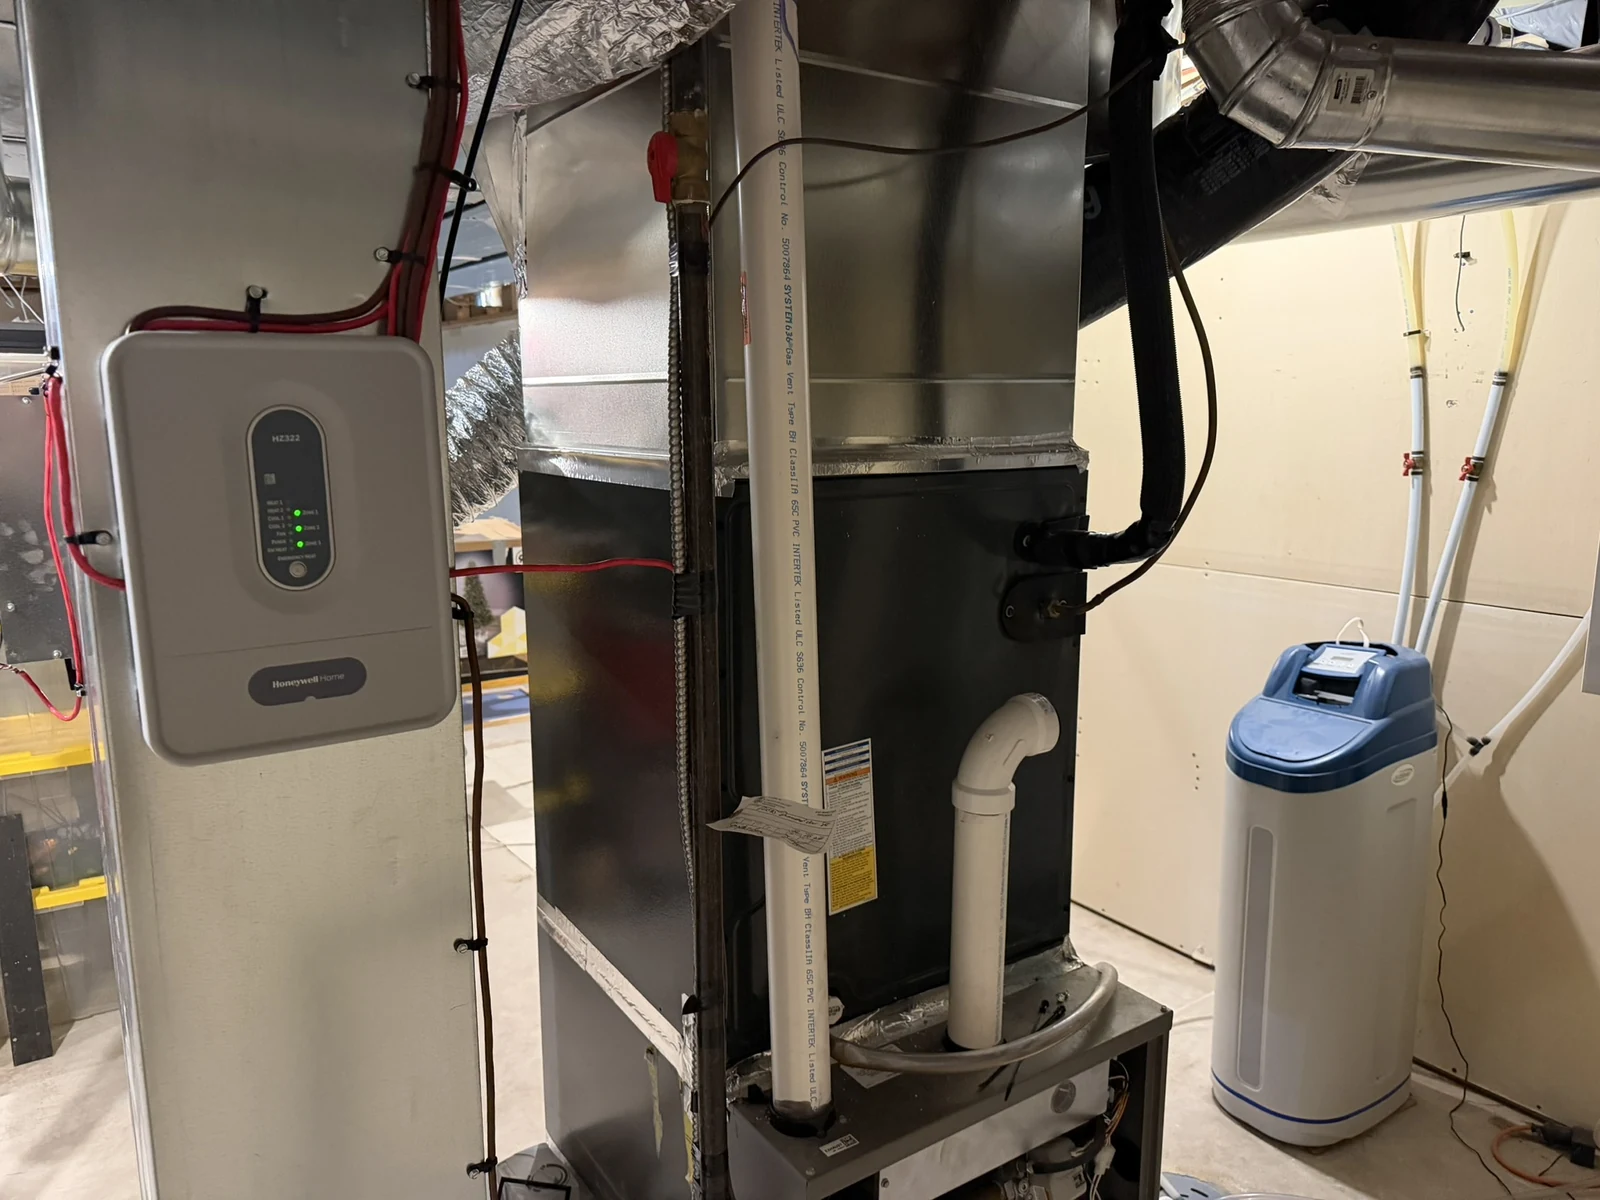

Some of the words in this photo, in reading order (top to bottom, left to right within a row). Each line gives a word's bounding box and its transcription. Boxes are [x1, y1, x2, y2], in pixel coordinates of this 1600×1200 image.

[773, 2, 783, 52] INTERTEK
[775, 58, 785, 98] Listed
[776, 104, 786, 124] ULC
[778, 161, 788, 206] Control
[780, 213, 790, 231] No.
[781, 238, 792, 280] 5007864
[786, 372, 796, 395] Vent
[787, 402, 796, 425] Type
[271, 433, 301, 443] HZ322
[788, 430, 797, 443] BH
[792, 519, 801, 537] PVC
[792, 543, 802, 587] INTERTEK
[794, 591, 803, 625] Listed
[795, 629, 804, 646] ULC
[796, 652, 805, 674] S636
[272, 675, 319, 689] Honeywell
[319, 672, 345, 683] Home
[797, 678, 806, 715] Control
[798, 720, 807, 736] No.
[799, 741, 808, 778] 5007864
[802, 856, 811, 878] Vent
[804, 908, 812, 920] BH
[806, 988, 815, 1003] PVC
[807, 1009, 816, 1048] INTERTEK
[808, 1053, 816, 1083] Listed
[809, 1087, 817, 1102] ULC
